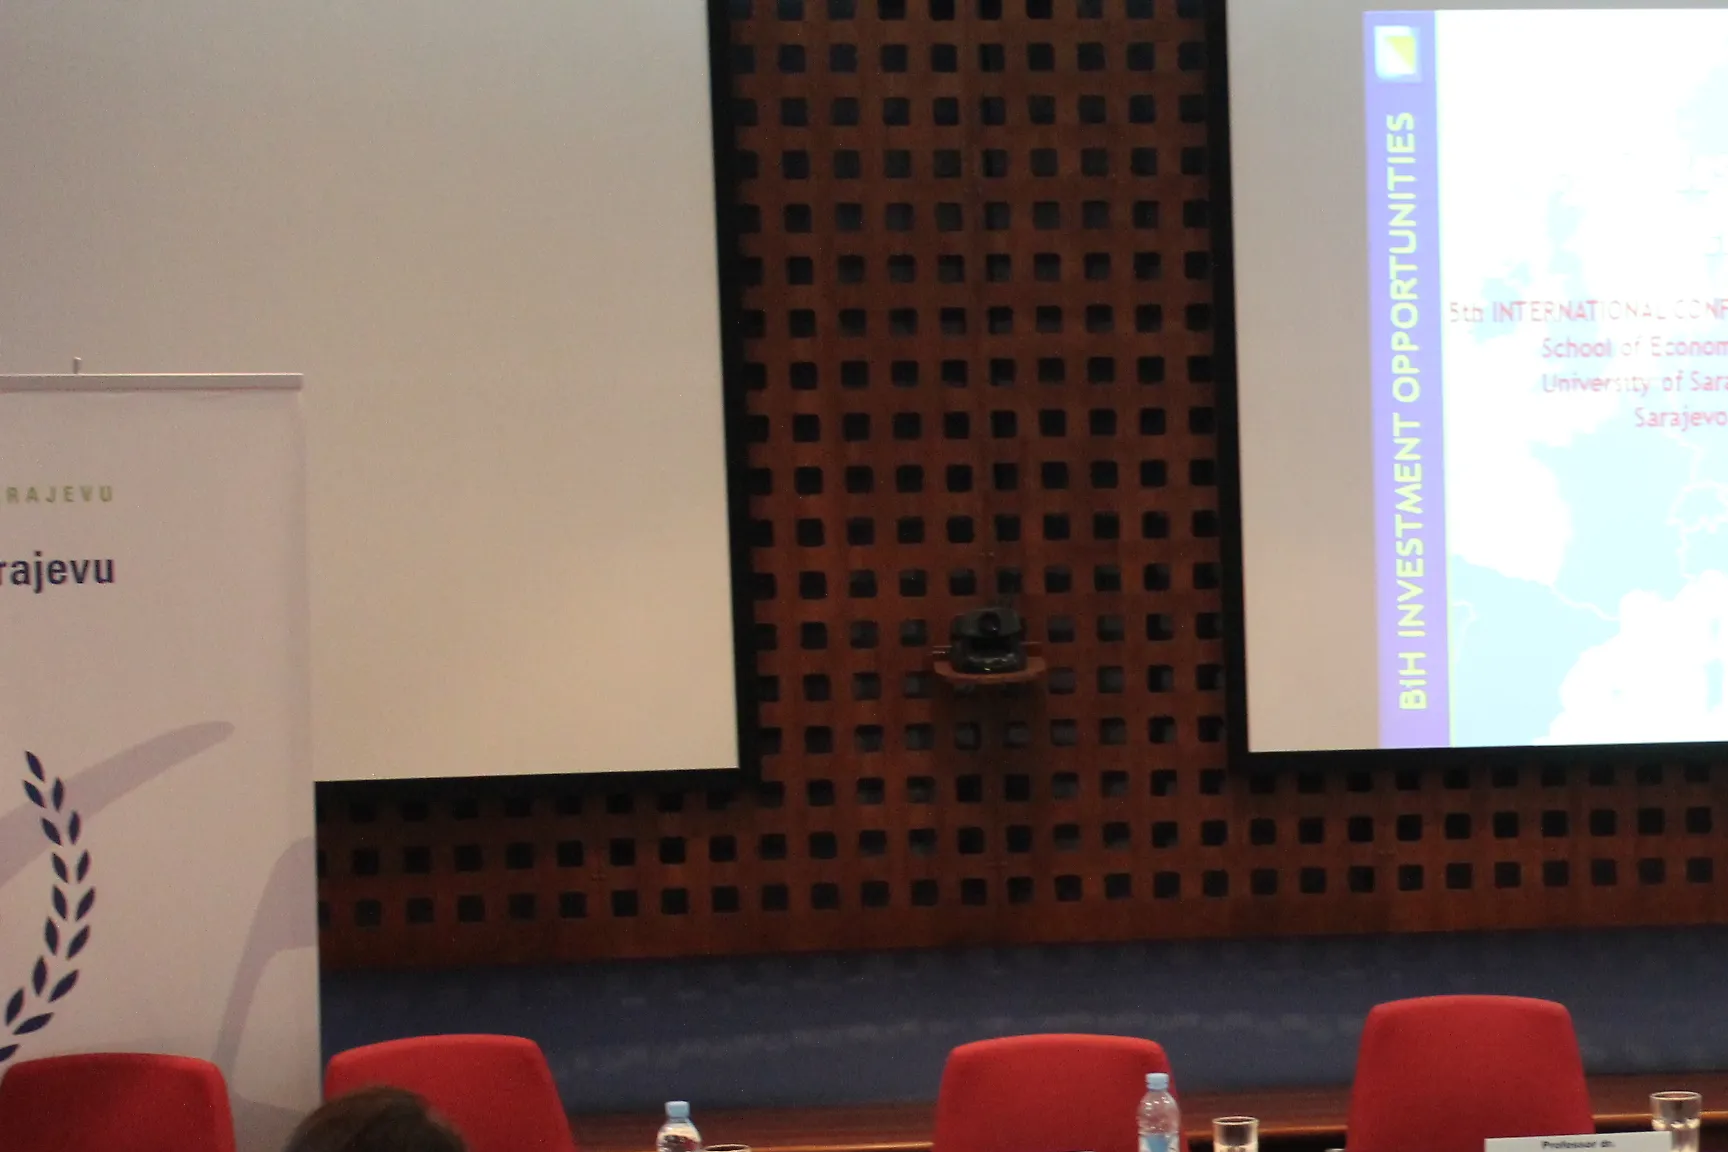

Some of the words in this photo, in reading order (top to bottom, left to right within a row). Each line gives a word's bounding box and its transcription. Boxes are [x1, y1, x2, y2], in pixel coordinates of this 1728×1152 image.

[1386, 112, 1421, 403] OPPORTUNITIES
[1449, 301, 1484, 323] 5th
[1492, 299, 1666, 322] INTERNATIONAL
[1542, 338, 1612, 358] School
[1620, 337, 1641, 356] of
[1542, 372, 1649, 396] University
[1663, 370, 1685, 392] of
[1392, 412, 1428, 637] INVESTMENT
